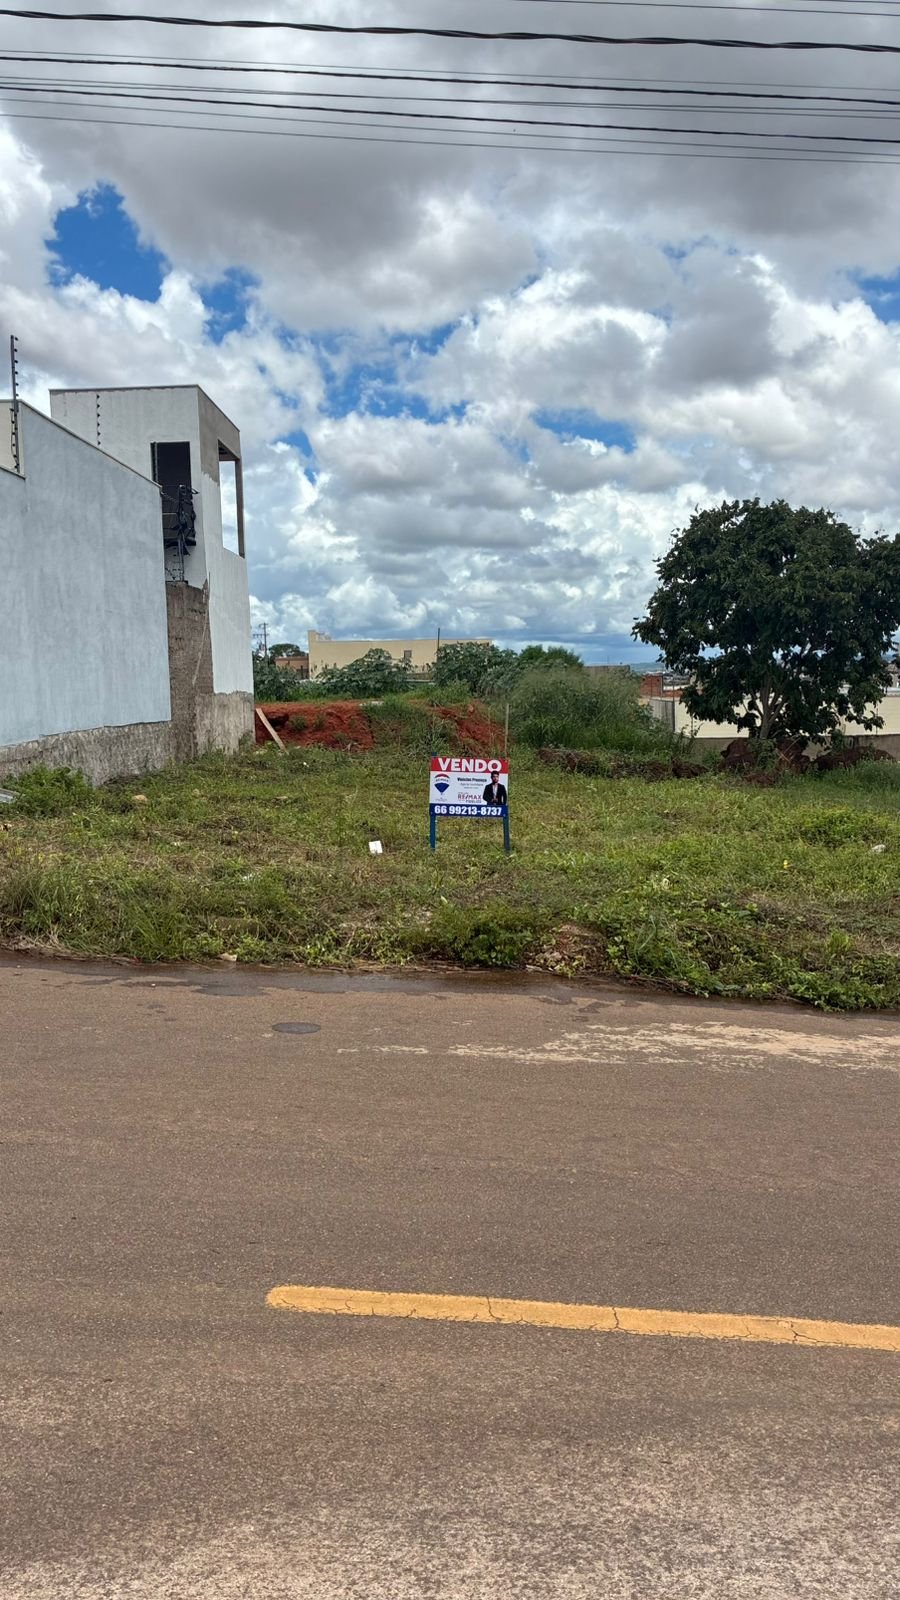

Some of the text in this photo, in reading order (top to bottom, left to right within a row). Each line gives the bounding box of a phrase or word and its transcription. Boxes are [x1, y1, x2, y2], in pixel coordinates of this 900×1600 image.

[438, 758, 502, 772] VENDO
[434, 805, 502, 816] 66 99213-8737
